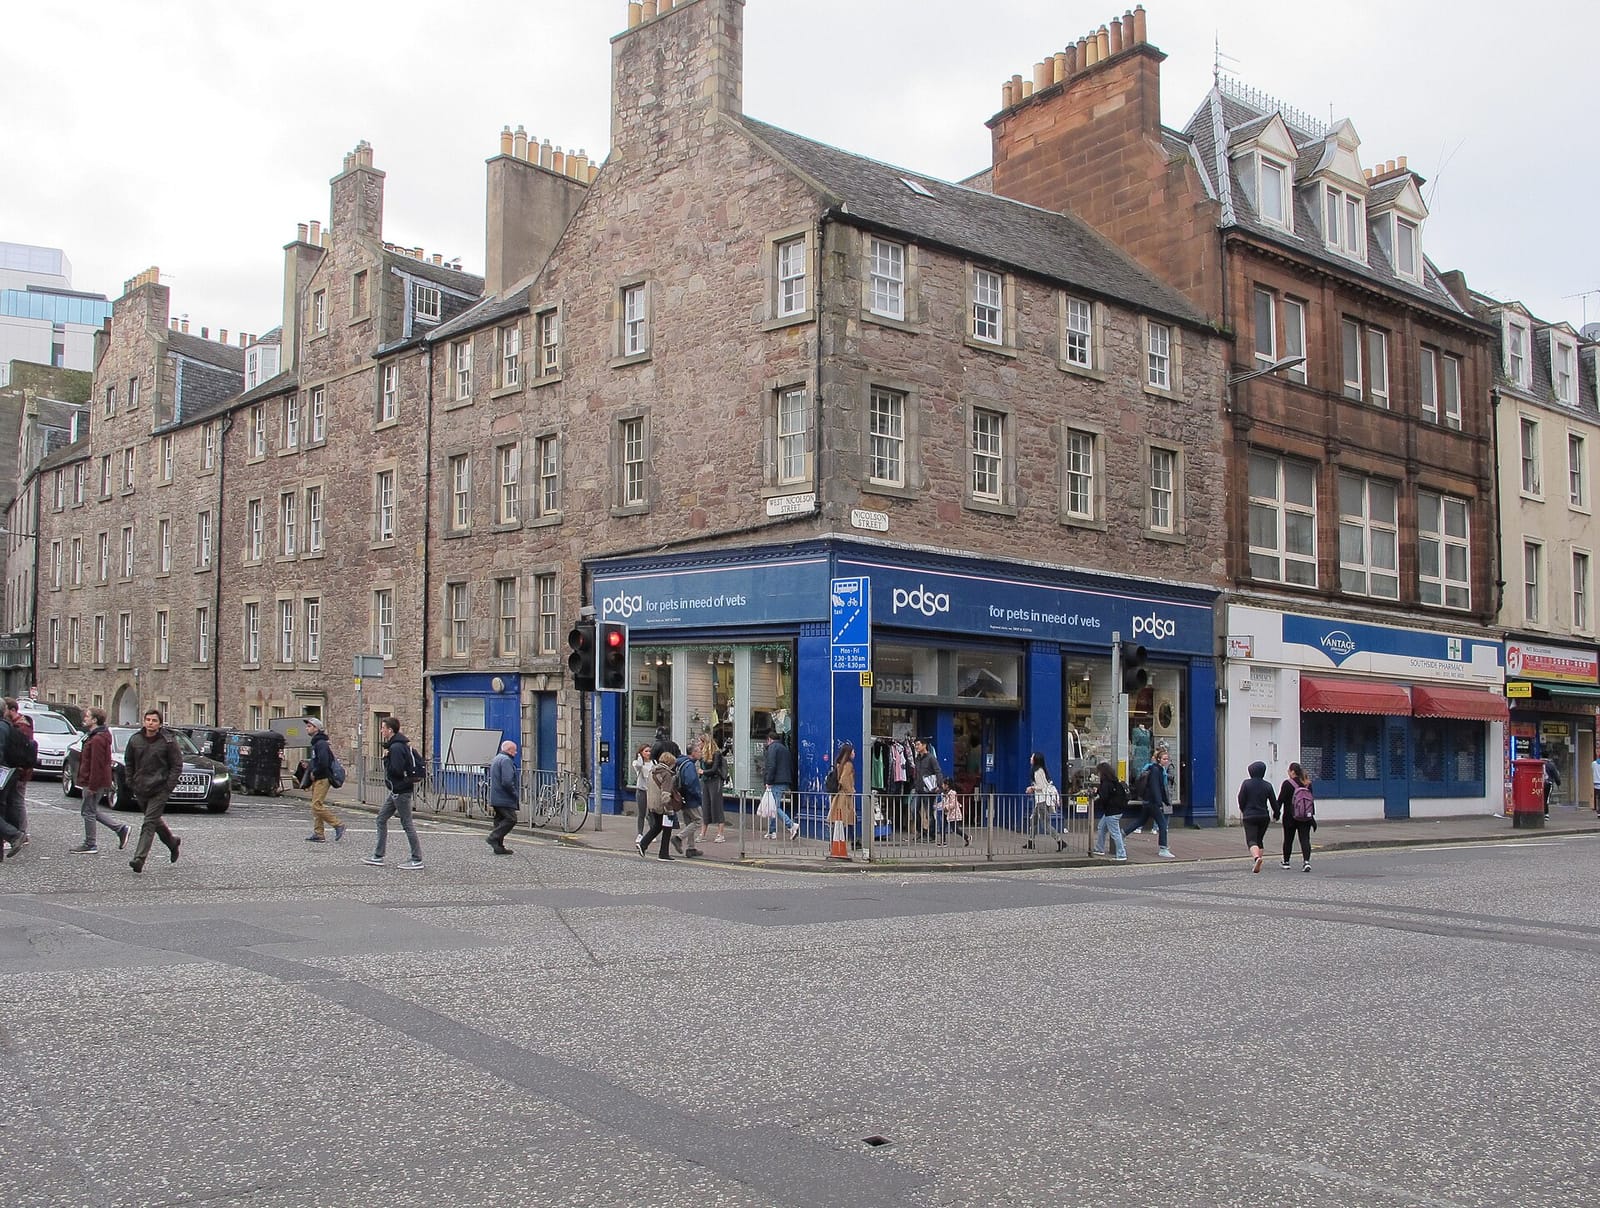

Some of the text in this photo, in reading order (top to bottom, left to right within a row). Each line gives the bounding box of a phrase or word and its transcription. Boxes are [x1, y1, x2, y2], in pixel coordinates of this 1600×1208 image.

[770, 494, 815, 507] WEST NICOLSON
[780, 504, 800, 513] STREET
[853, 511, 887, 522] NICOLSON
[859, 520, 882, 529] STREET
[602, 590, 642, 620] pdsa
[646, 594, 746, 612] for pets in need of vets
[893, 584, 949, 616] pdsa
[989, 605, 1100, 628] for pets in need of vets
[1132, 612, 1175, 640] pdsa
[1320, 636, 1356, 650] VANTAGE
[1438, 662, 1464, 672] PHARMACY
